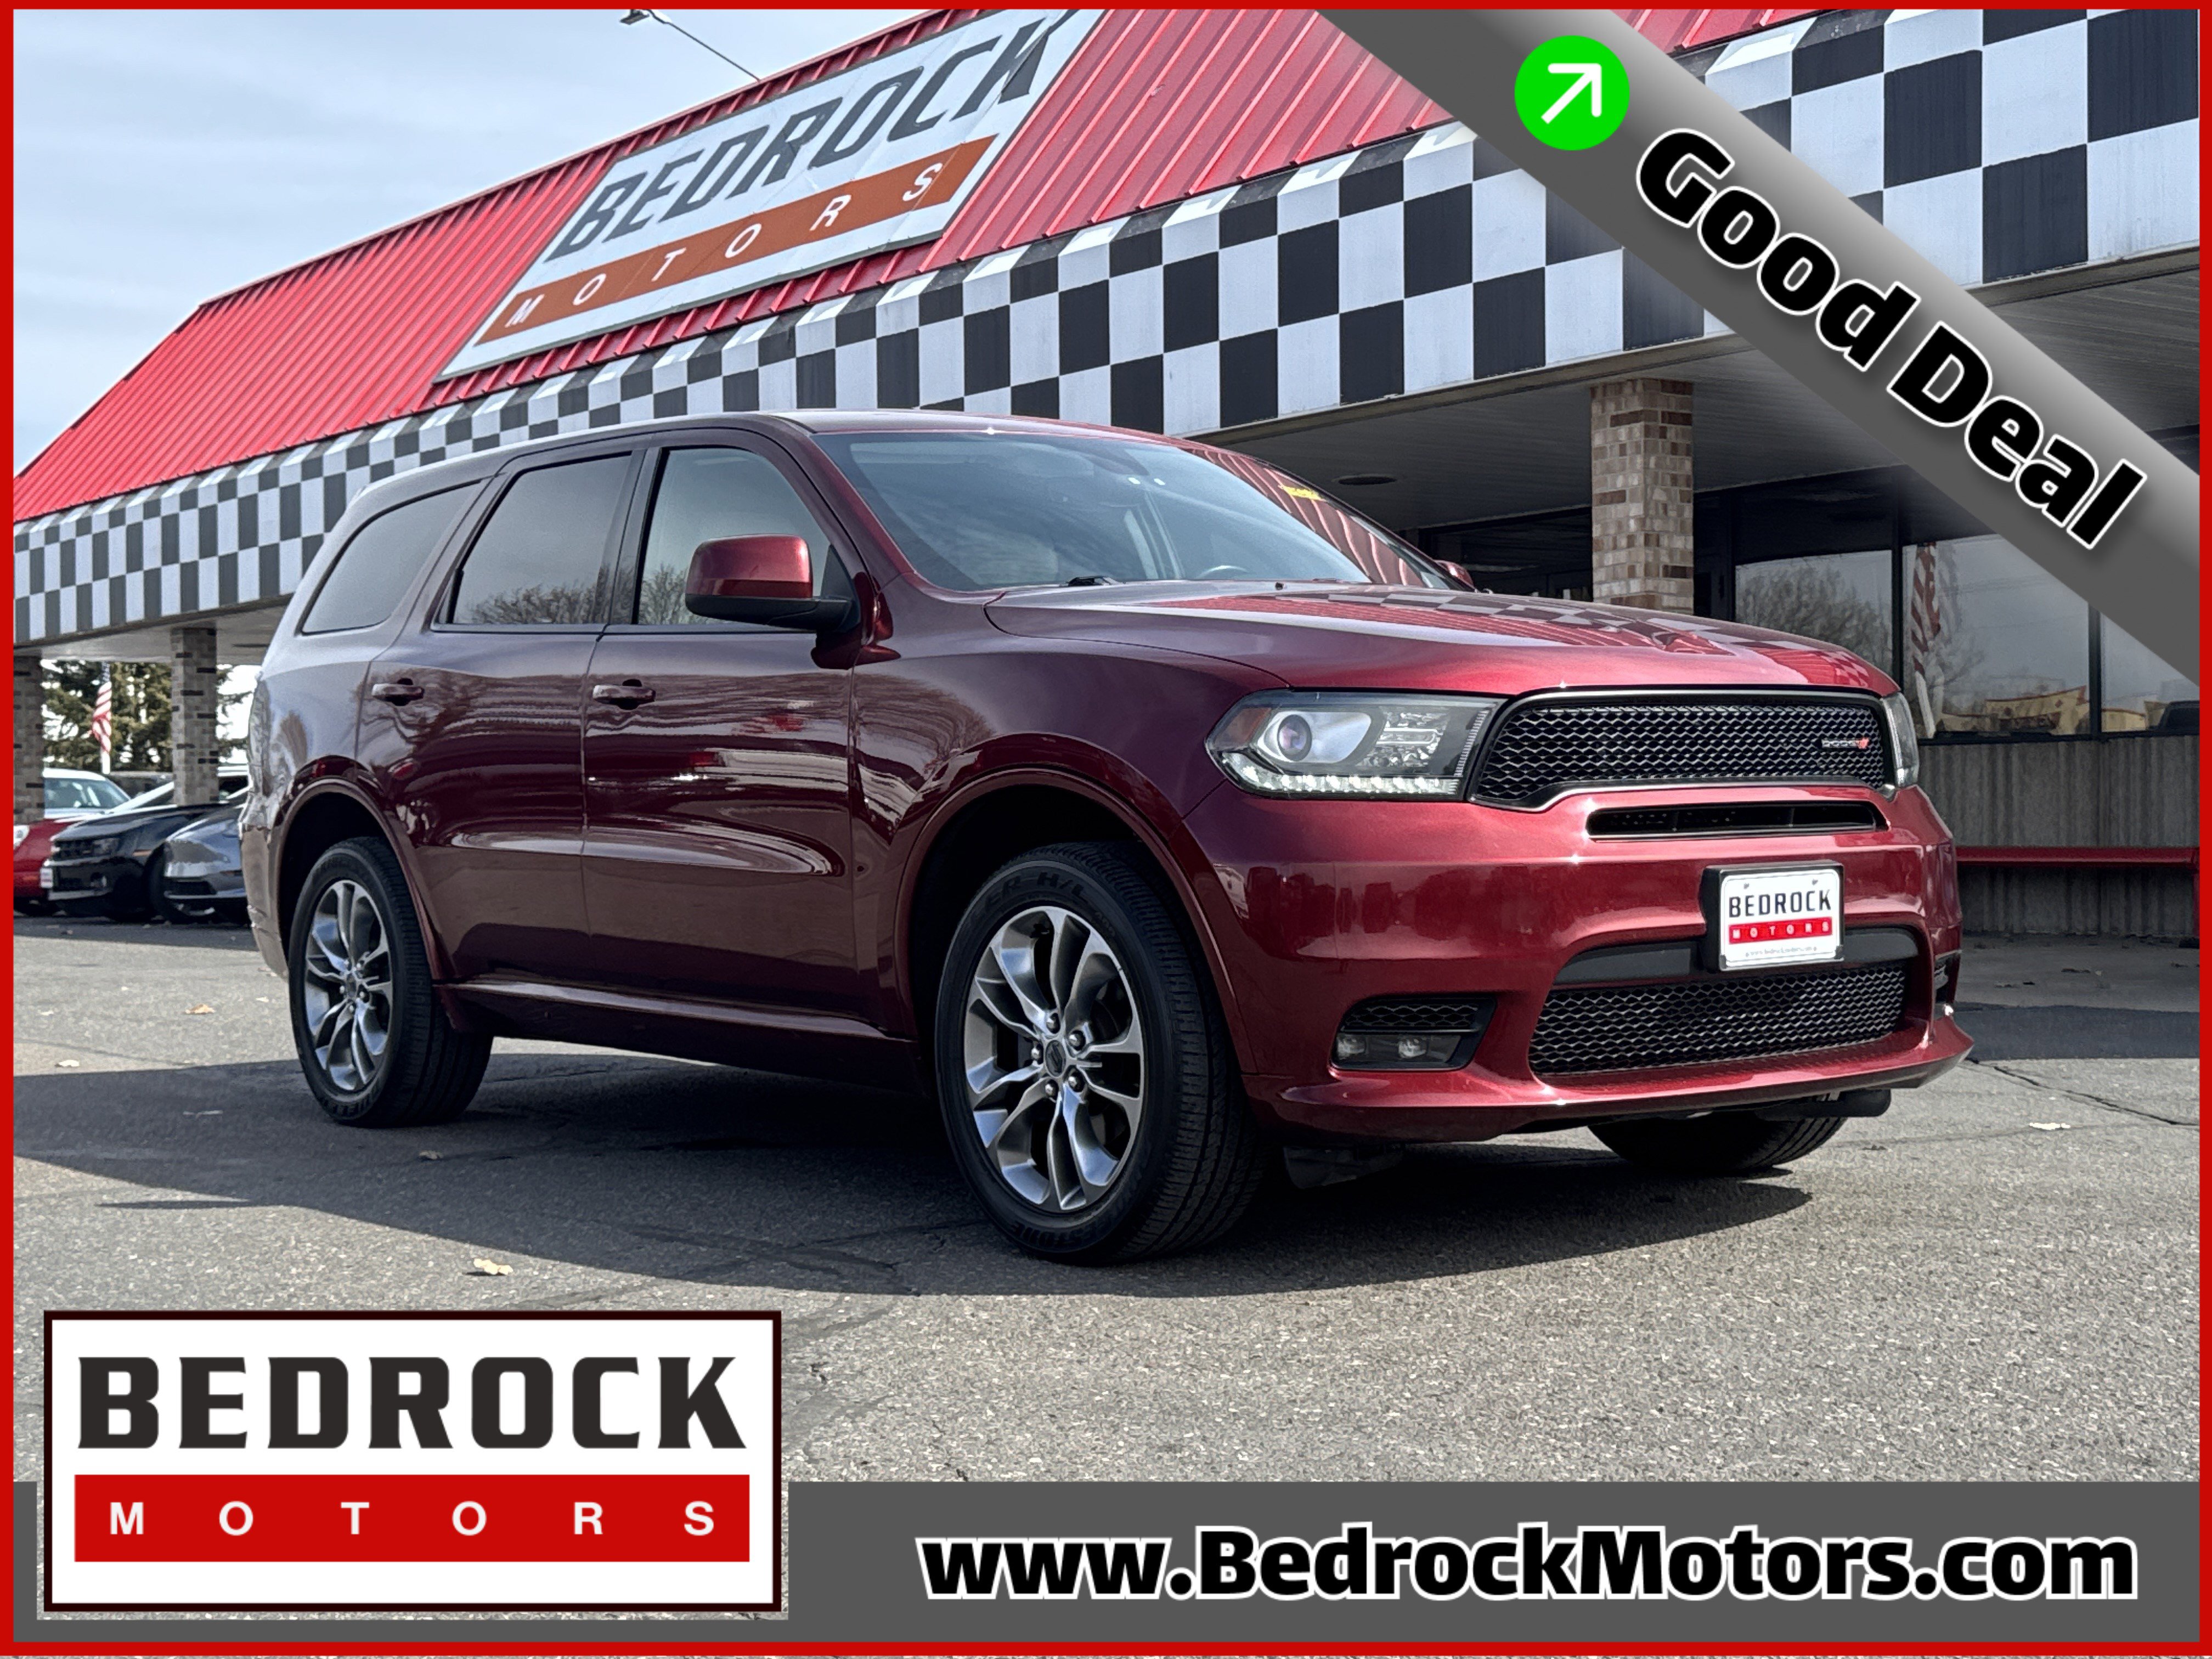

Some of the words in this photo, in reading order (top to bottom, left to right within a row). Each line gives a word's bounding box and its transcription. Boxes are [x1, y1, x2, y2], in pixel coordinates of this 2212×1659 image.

[545, 9, 1080, 262] BEDROCK
[505, 162, 944, 328] MOTORS
[1729, 889, 1832, 918] BEDROCK
[1732, 921, 1830, 939] MOTORS
